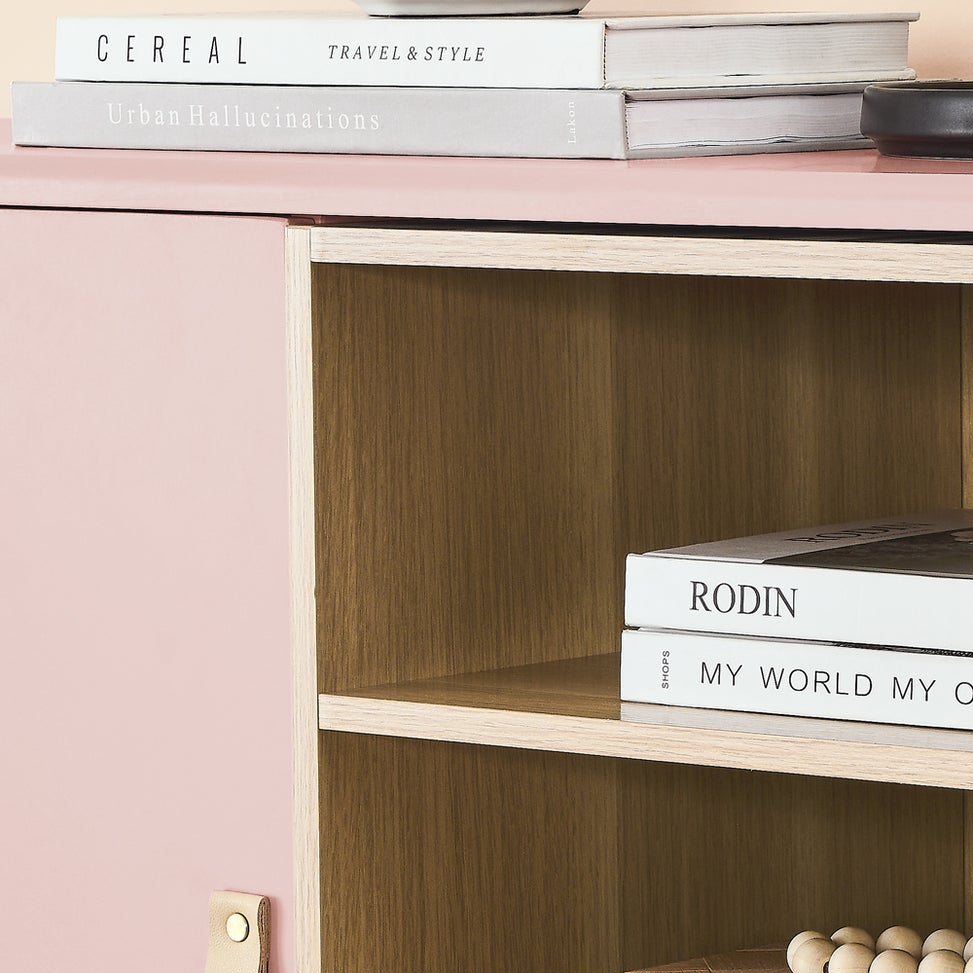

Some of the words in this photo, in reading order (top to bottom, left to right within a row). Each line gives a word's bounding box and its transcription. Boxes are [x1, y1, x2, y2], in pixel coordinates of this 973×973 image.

[97, 34, 248, 66] CEREAL
[328, 45, 401, 61] TRAVEL
[407, 46, 418, 61] &
[424, 46, 485, 62] STYLE
[107, 102, 180, 126] Urban
[189, 104, 381, 130] Hallucinations
[689, 580, 798, 619] RODIN
[661, 650, 670, 689] SHOPS
[701, 661, 743, 688] MY
[759, 666, 873, 698] WORLD
[892, 676, 938, 703] MY
